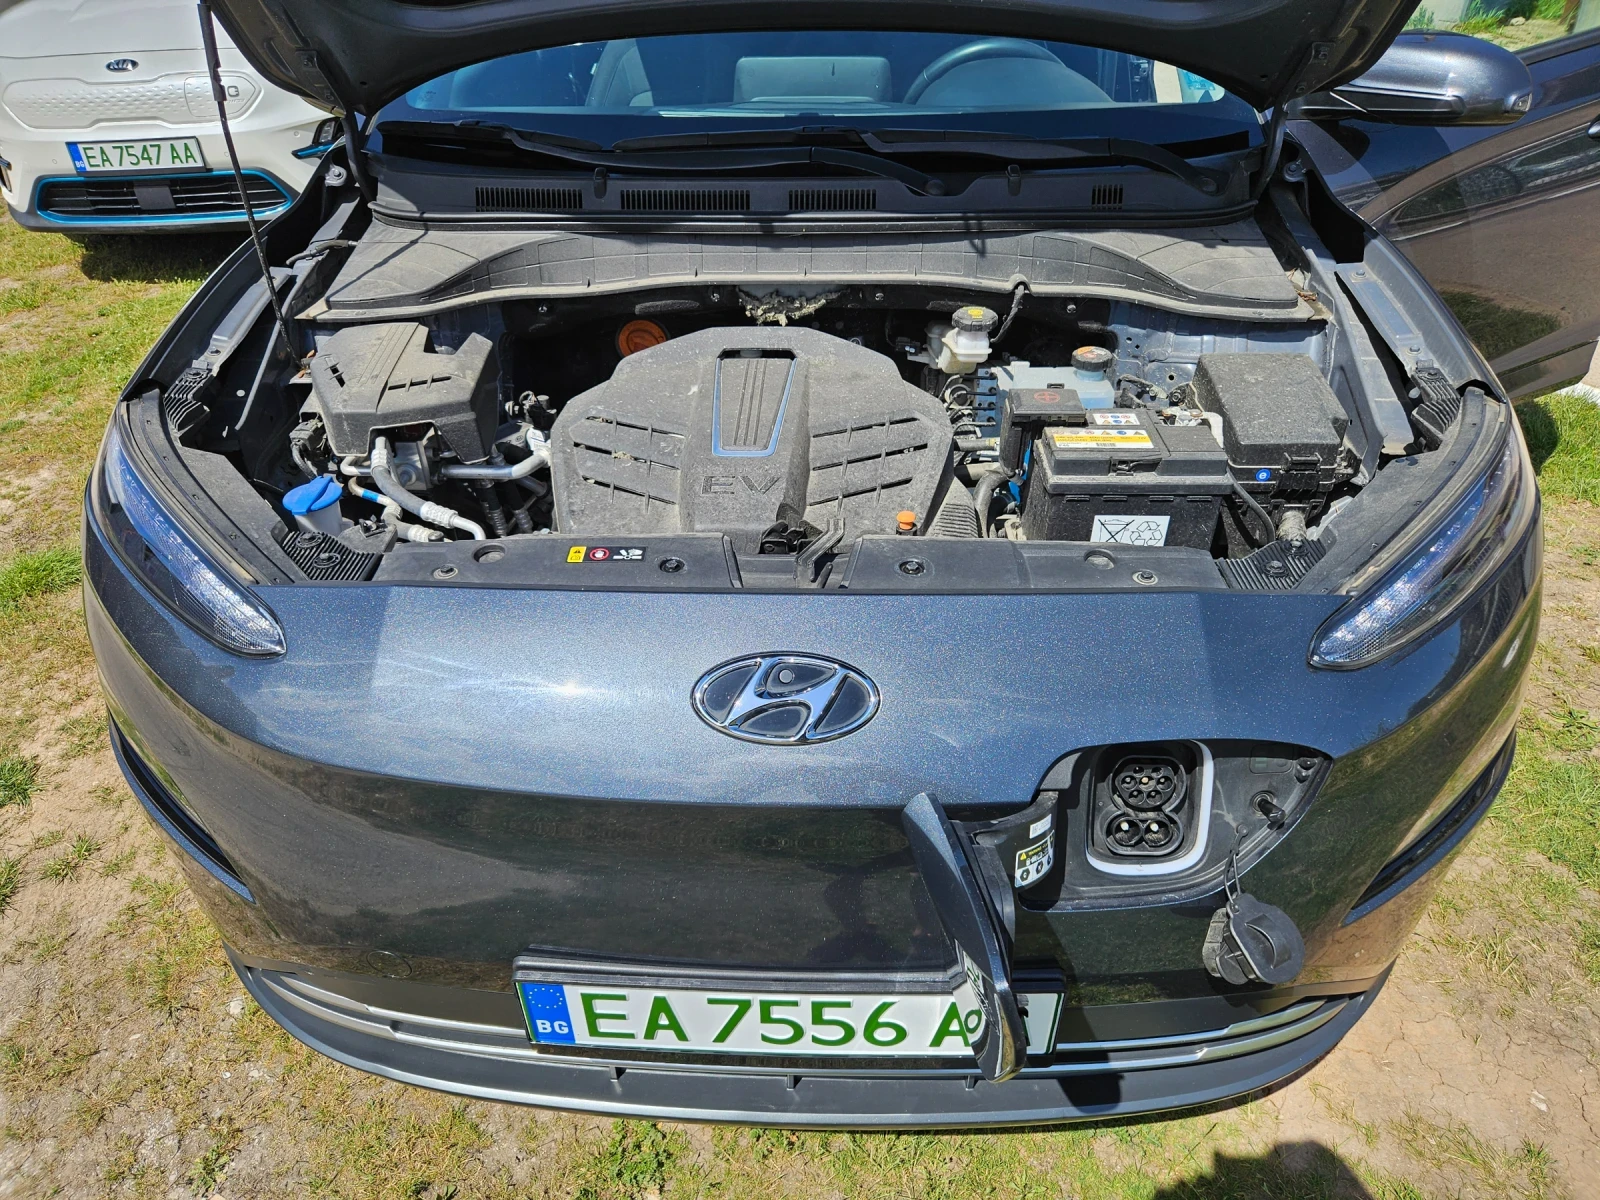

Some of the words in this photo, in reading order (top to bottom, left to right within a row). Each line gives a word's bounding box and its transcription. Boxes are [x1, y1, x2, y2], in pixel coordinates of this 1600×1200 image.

[109, 59, 133, 71] KIA
[75, 160, 85, 168] BG
[83, 146, 114, 168] EA
[111, 144, 161, 166] 7547
[169, 142, 198, 165] AA
[701, 475, 781, 495] EV
[536, 1019, 569, 1035] BG
[580, 992, 690, 1042] EA
[706, 997, 908, 1047] 7556
